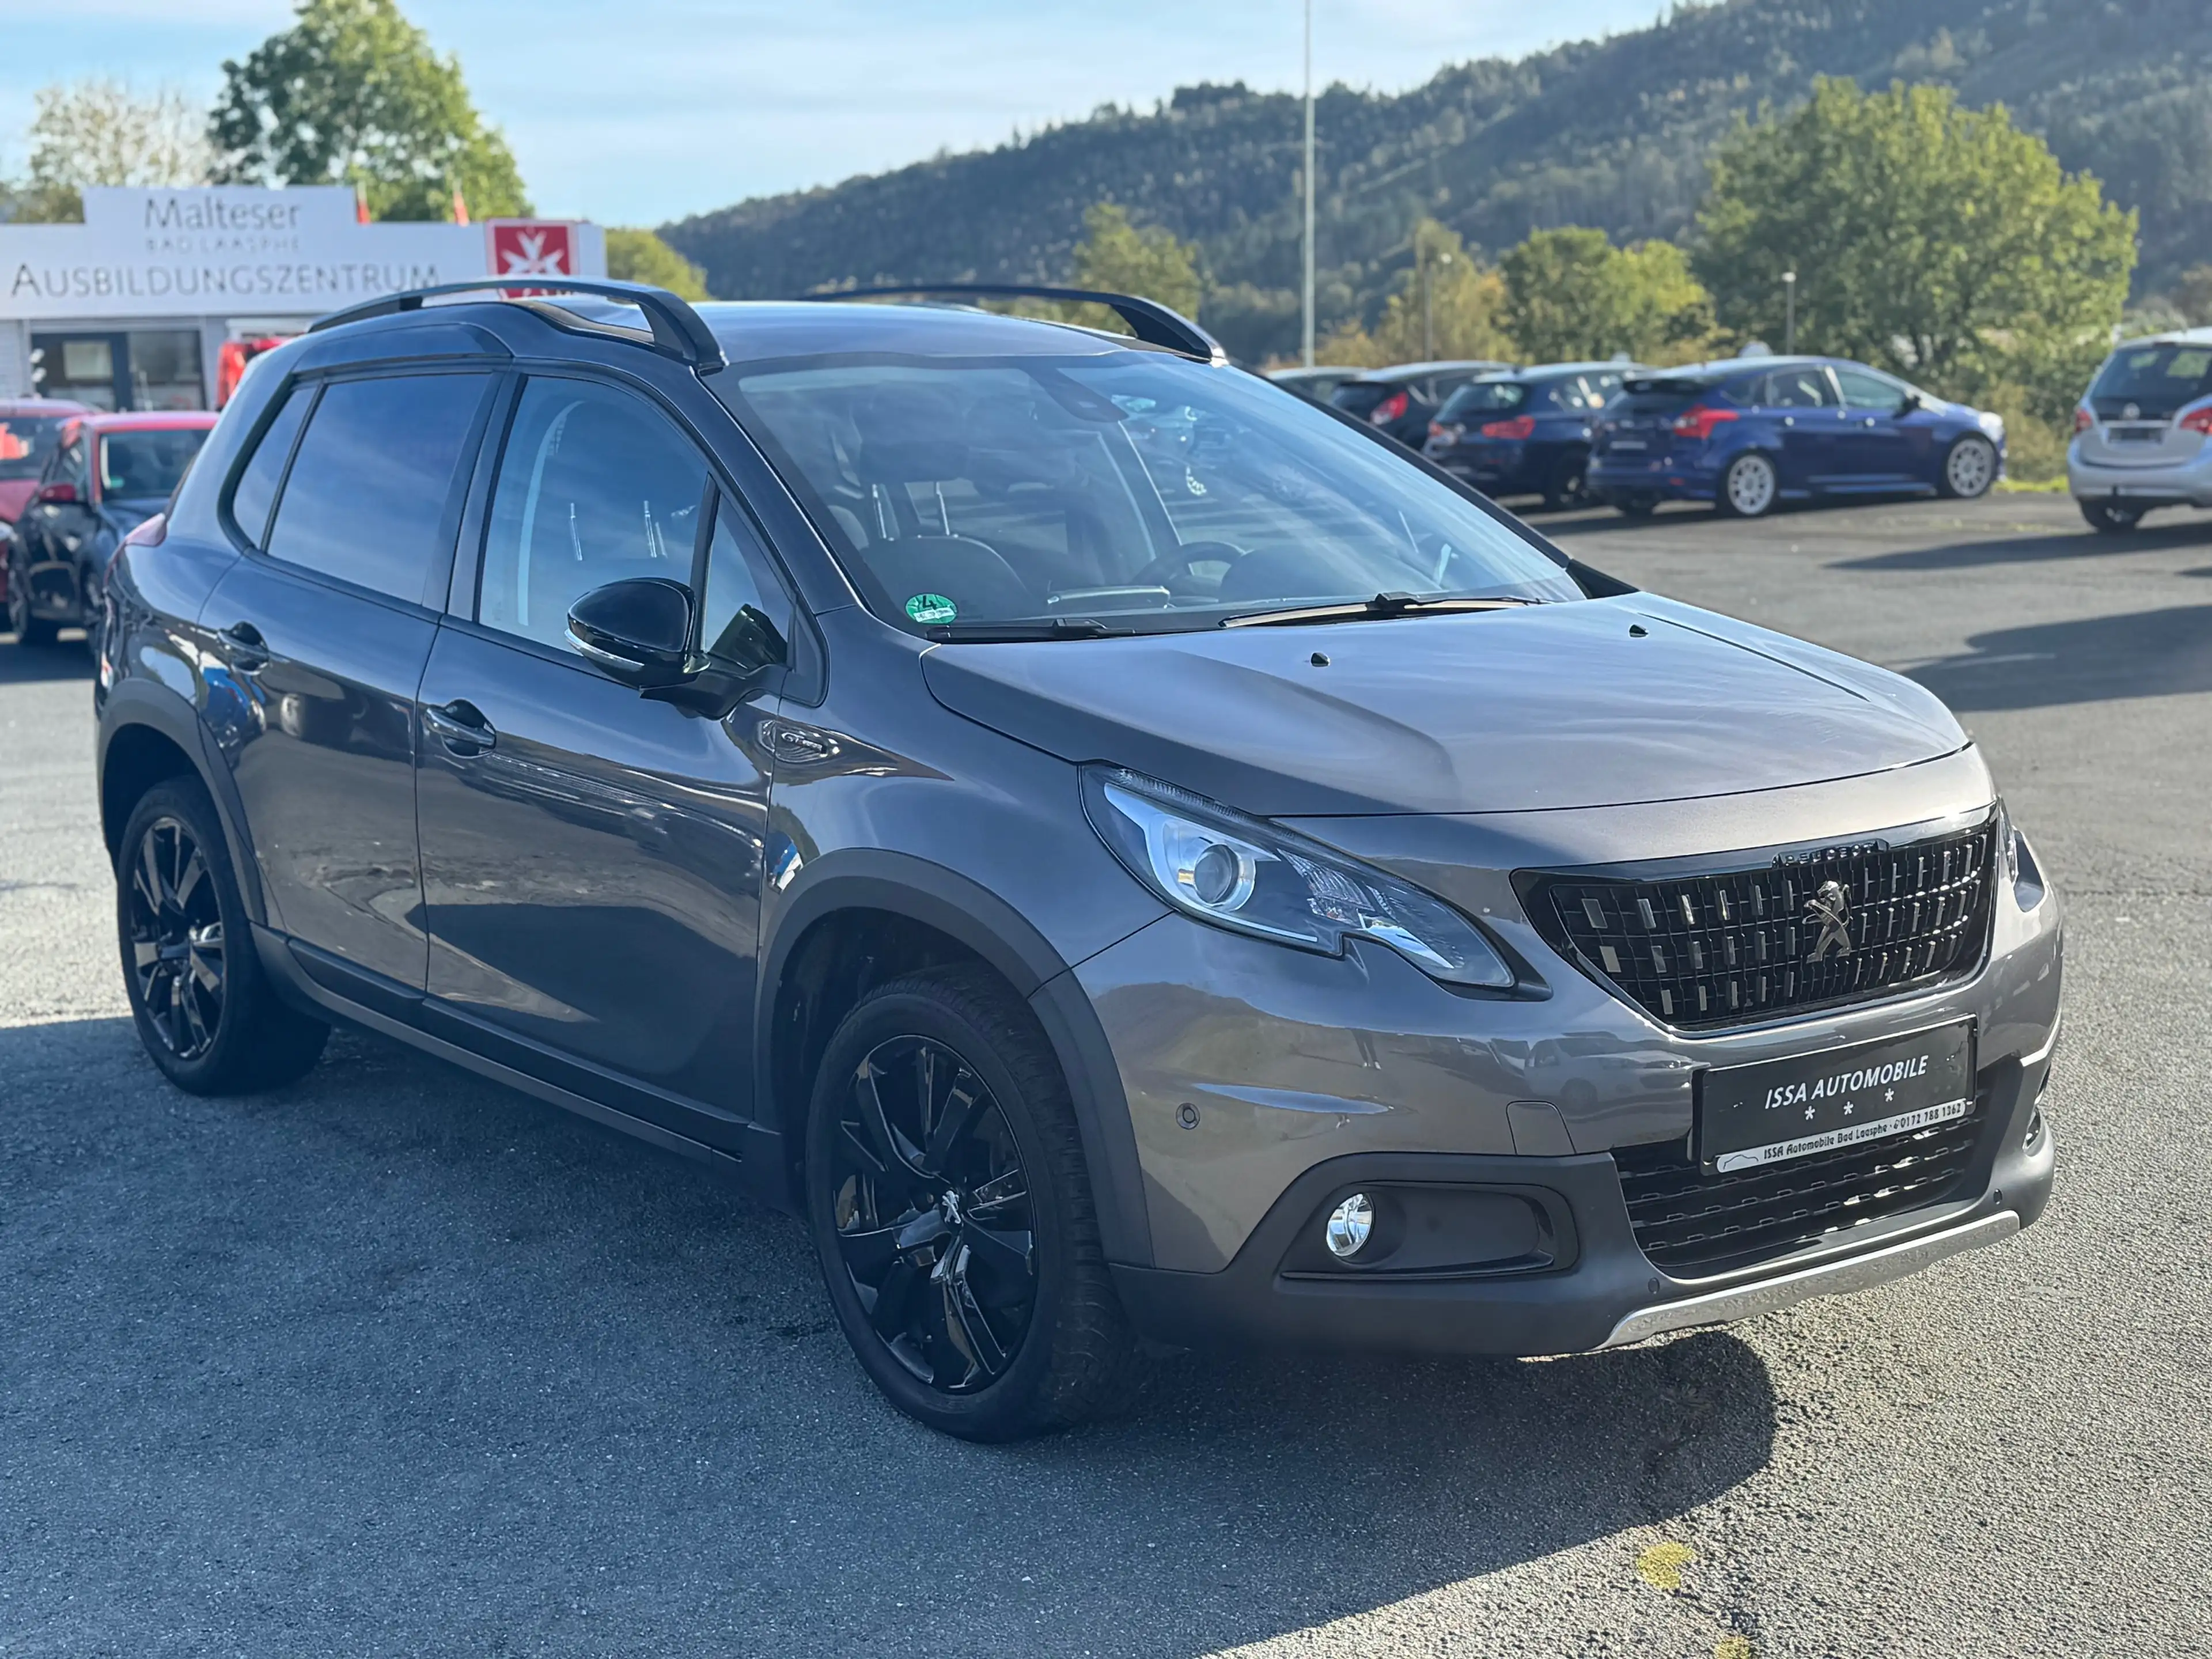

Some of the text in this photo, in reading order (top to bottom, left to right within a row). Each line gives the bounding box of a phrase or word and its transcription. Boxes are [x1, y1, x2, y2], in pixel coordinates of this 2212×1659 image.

[145, 196, 302, 230] Malteser
[146, 236, 192, 254] BAD
[12, 263, 440, 297] AUSBILDUNGSZENTRUM
[922, 595, 937, 611] 4
[1764, 1055, 1929, 1109] ISSA AUTOMOBILE
[1764, 1103, 1961, 1160] ISSA Automobile Bad Laasphe 0172 788 1362
